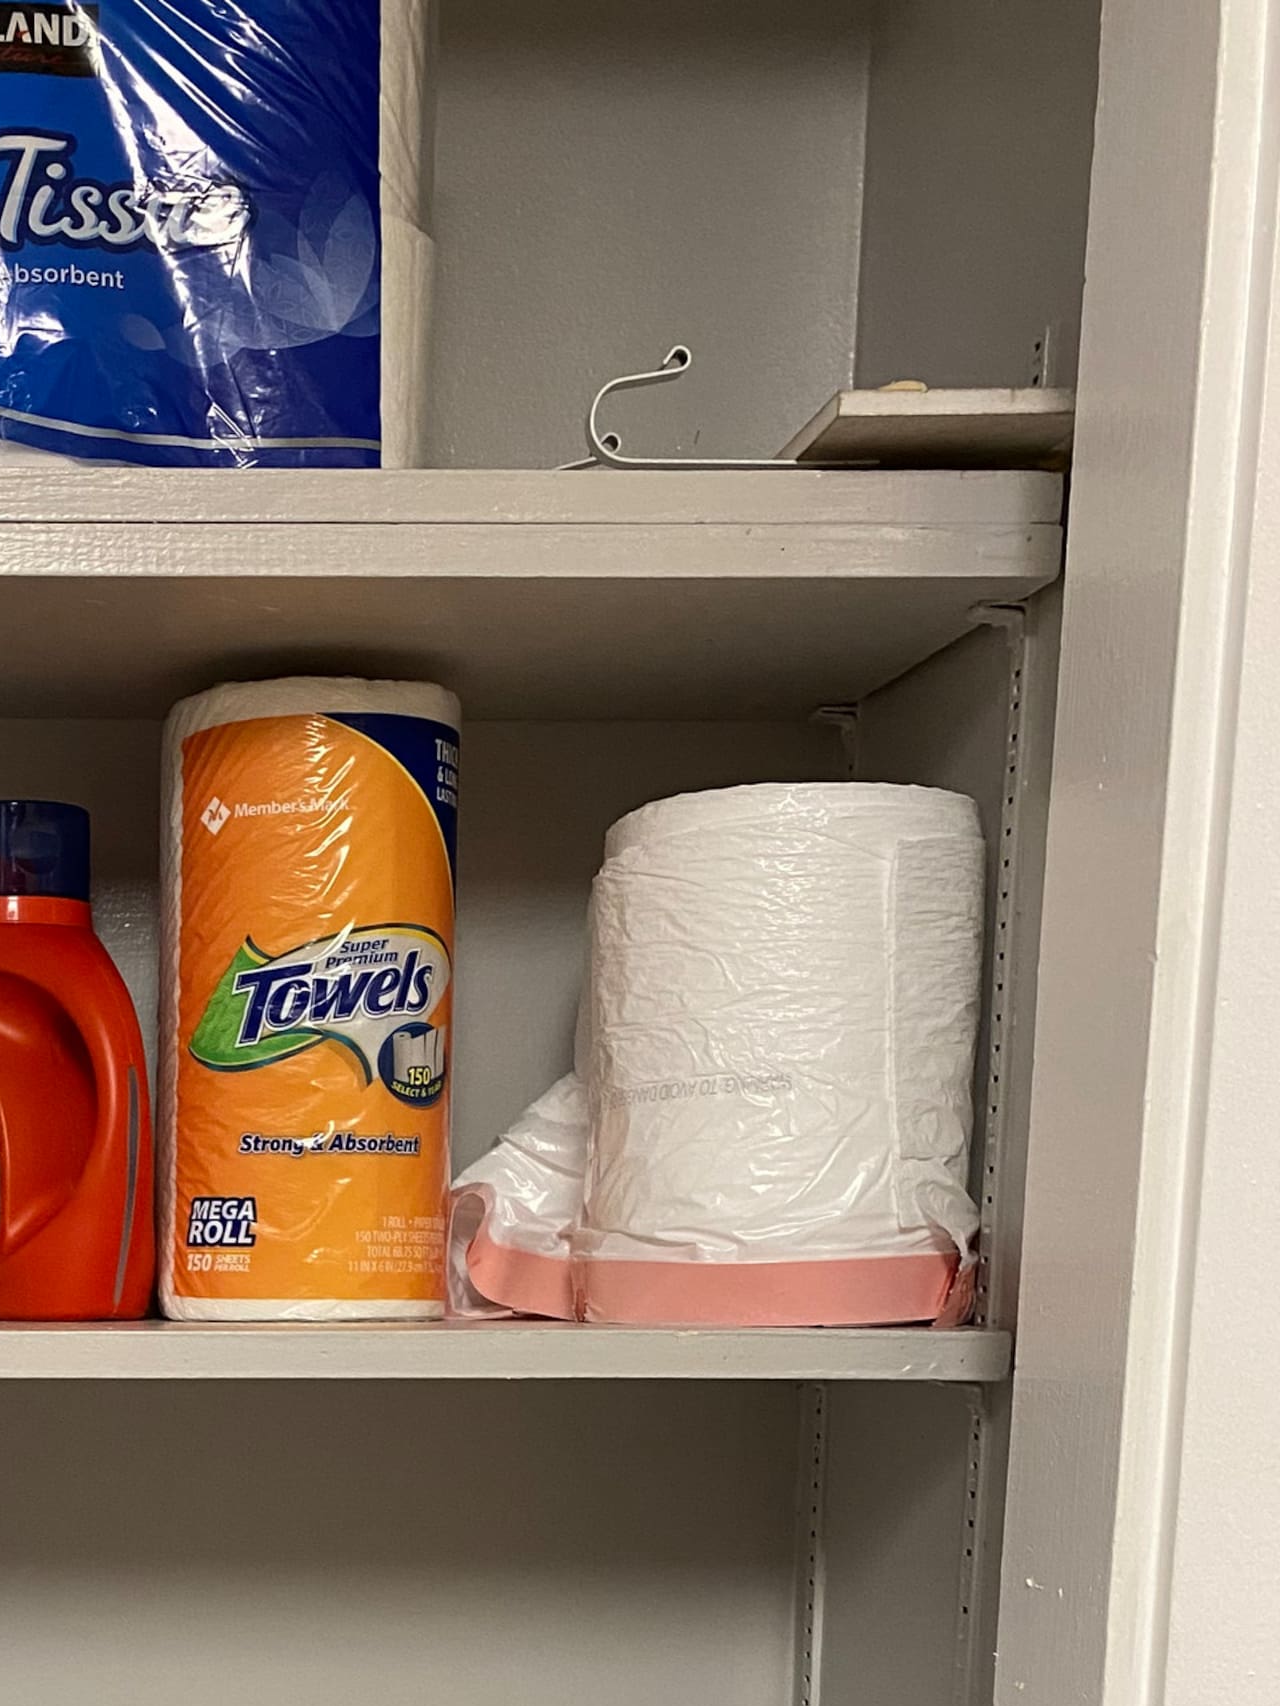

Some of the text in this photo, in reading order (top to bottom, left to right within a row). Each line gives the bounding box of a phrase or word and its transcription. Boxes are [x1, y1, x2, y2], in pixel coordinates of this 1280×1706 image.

[234, 800, 307, 818] Member's
[339, 939, 389, 956] Super
[325, 951, 398, 969] Premium
[234, 949, 434, 1046] Towels
[408, 1067, 431, 1085] 150
[239, 1134, 304, 1155] Strong
[328, 1133, 420, 1153] Absorbent
[191, 1200, 254, 1220] MEGA
[188, 1220, 253, 1244] ROLL
[355, 1231, 372, 1242] 150
[367, 1246, 391, 1257] TOTAL
[187, 1253, 213, 1272] 150
